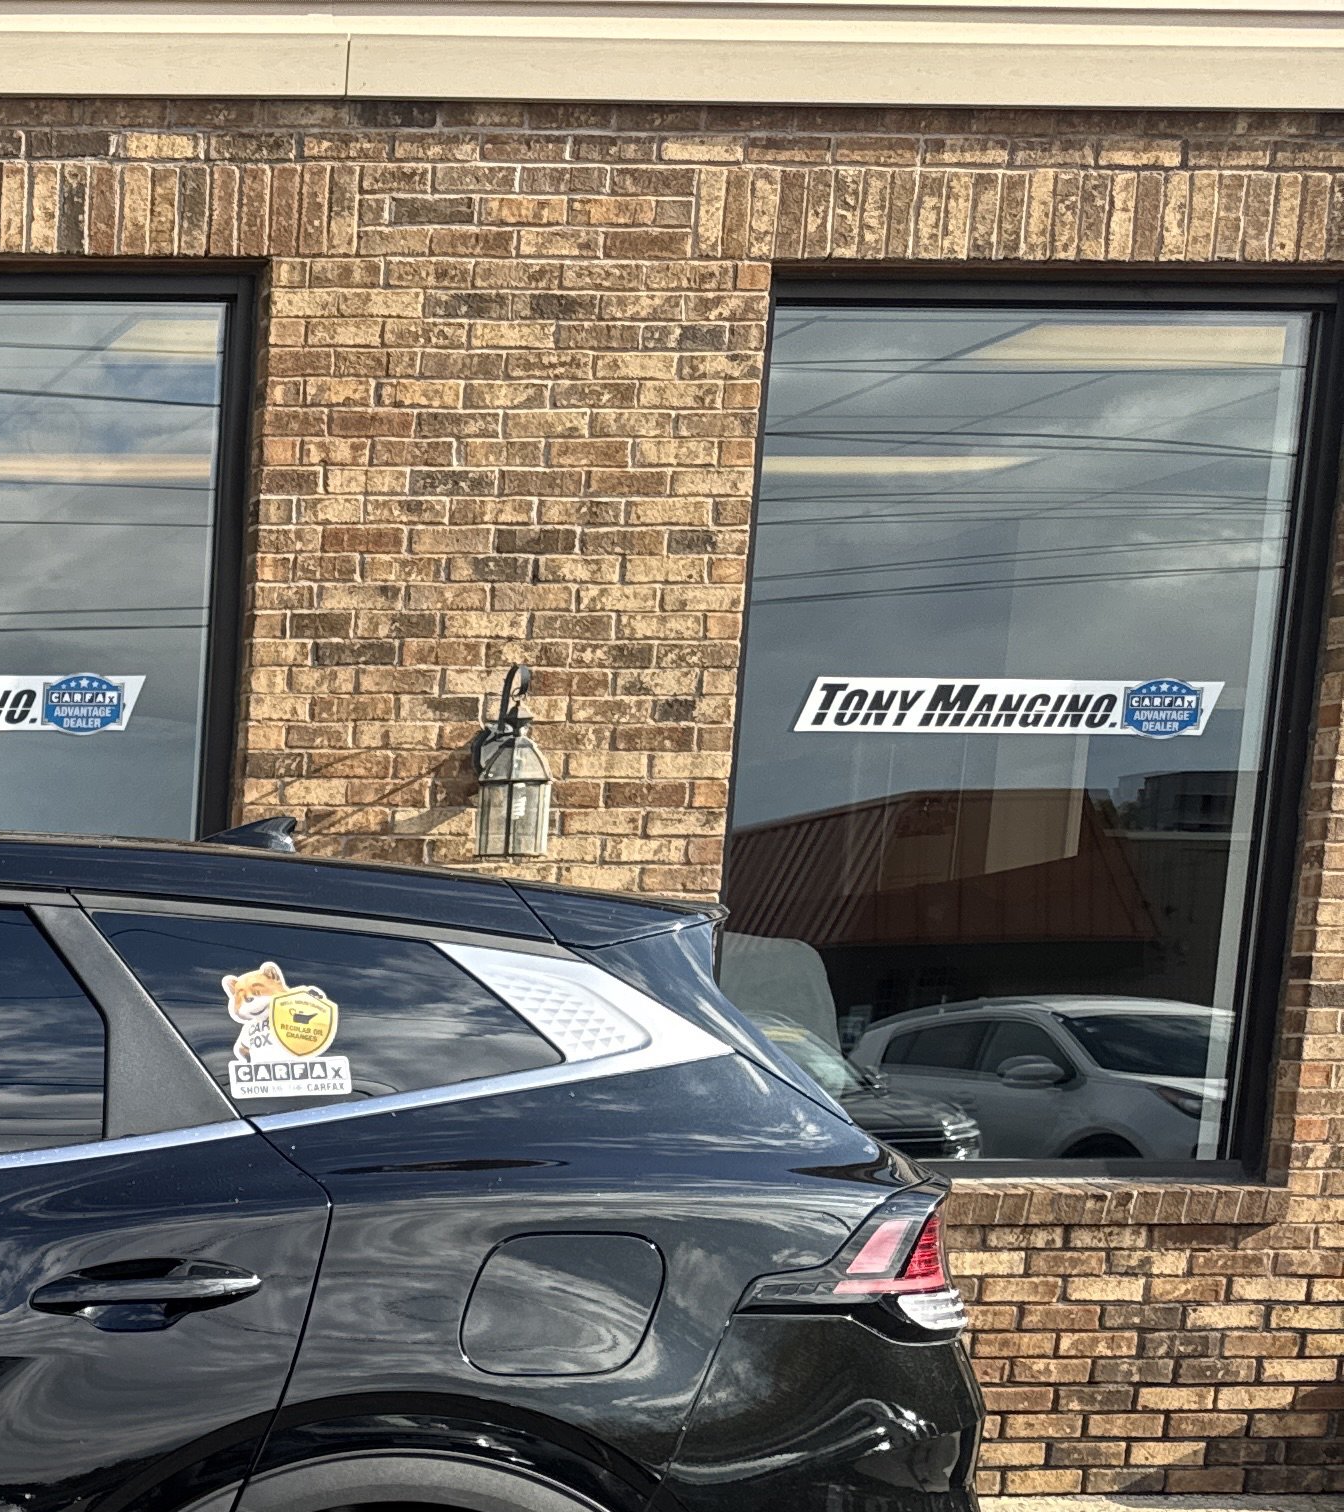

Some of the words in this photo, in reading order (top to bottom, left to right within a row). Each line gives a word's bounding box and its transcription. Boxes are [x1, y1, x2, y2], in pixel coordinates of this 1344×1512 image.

[49, 691, 118, 705] CARFAX
[811, 683, 925, 727] TONY
[1129, 695, 1197, 709] CARFAX
[53, 706, 113, 718] ADVANTAGE
[1133, 710, 1192, 722] ADVANTAGE
[63, 717, 101, 729] DEALER
[1141, 721, 1180, 732] DEALER
[248, 1016, 270, 1036] CAR
[250, 1033, 273, 1048] FOX
[235, 1062, 343, 1083] CARFAX
[240, 1085, 269, 1094] SHOW
[307, 1083, 344, 1092] CARFAX
